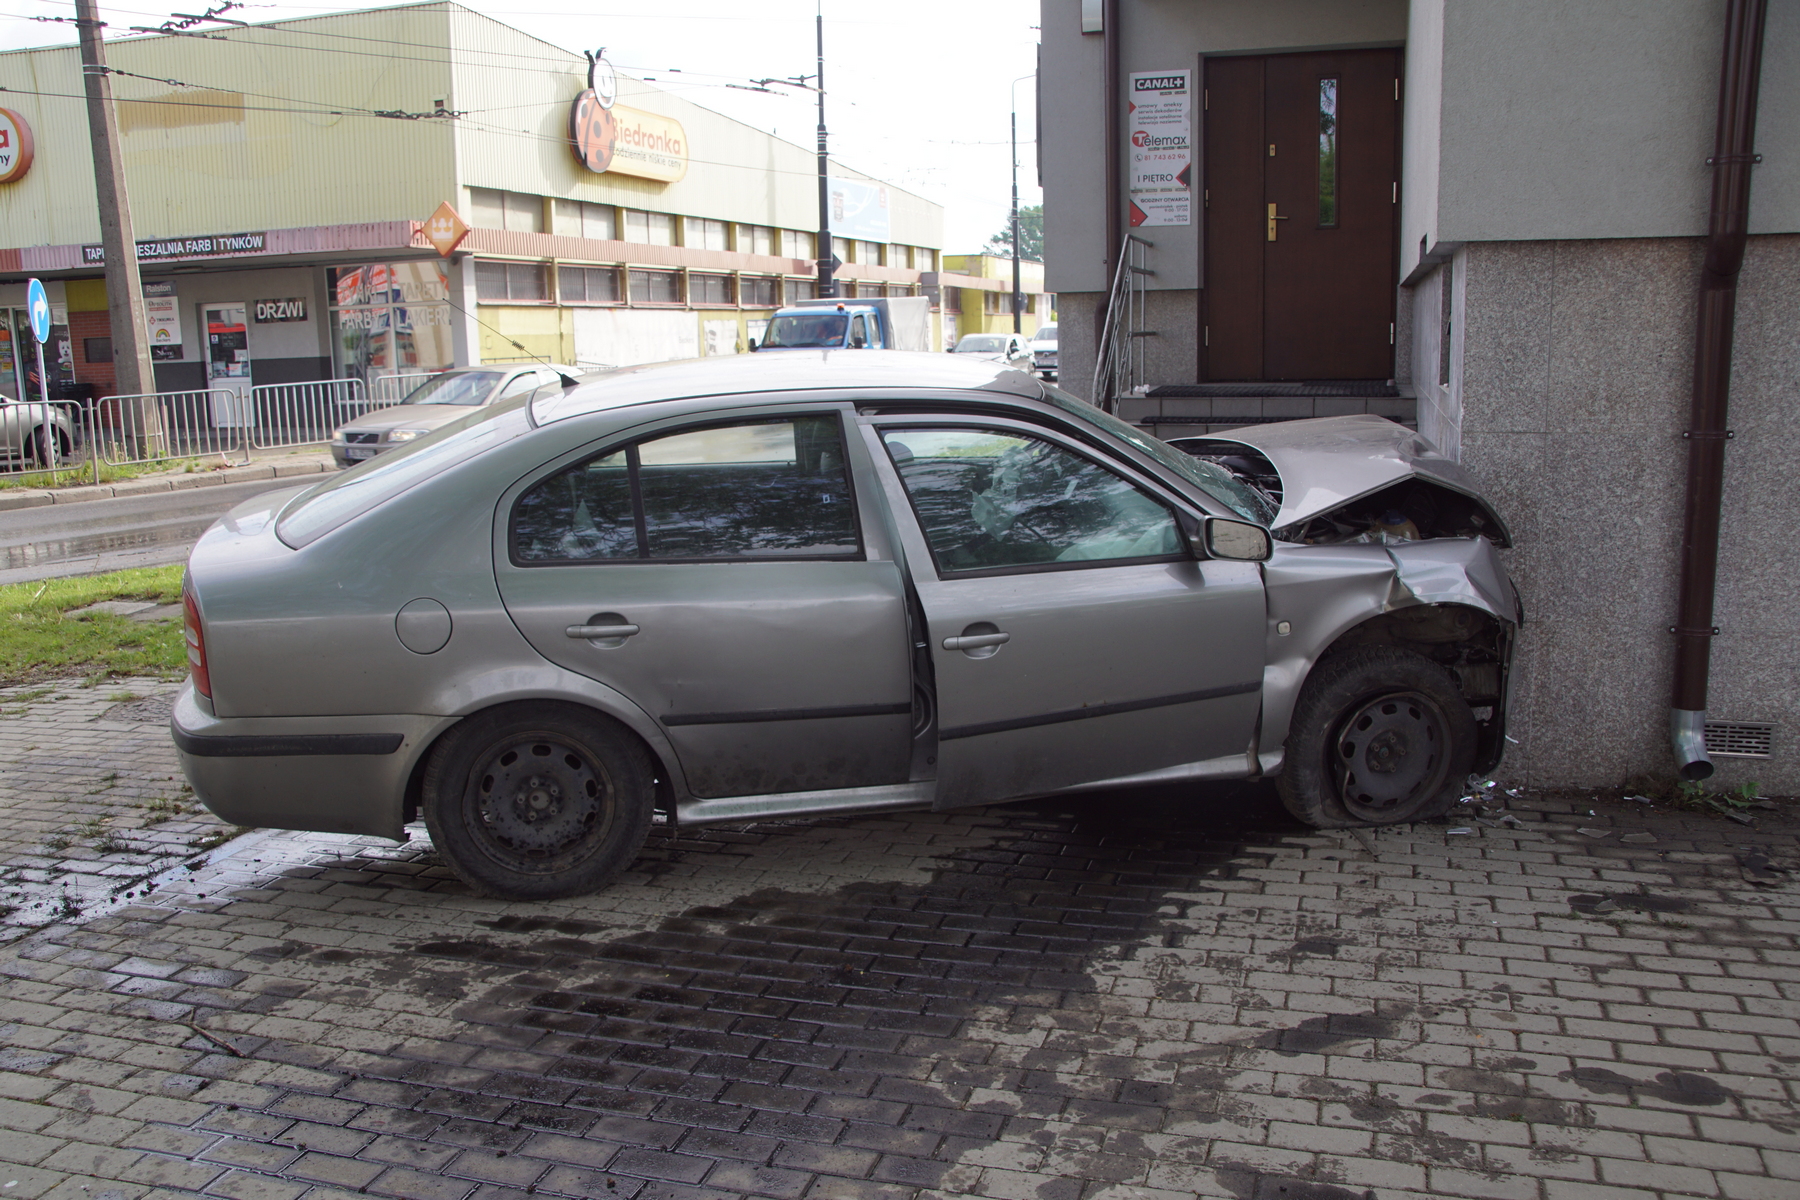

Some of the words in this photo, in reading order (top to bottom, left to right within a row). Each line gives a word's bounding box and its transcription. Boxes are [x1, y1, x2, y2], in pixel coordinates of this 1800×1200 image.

[1136, 78, 1183, 89] CANAL+
[613, 117, 681, 156] Biedronka
[1133, 133, 1187, 147] Telemax
[668, 158, 682, 171] ceny
[1143, 174, 1173, 184] PIĘTRO
[186, 239, 211, 253] FARB
[213, 238, 217, 251] I
[218, 234, 263, 250] TYNKÓW
[146, 285, 171, 293] Ralston
[400, 280, 447, 301] TAPETY
[257, 302, 303, 319] DRZWI
[340, 312, 380, 330] FARBY
[397, 307, 451, 327] LAKIERY
